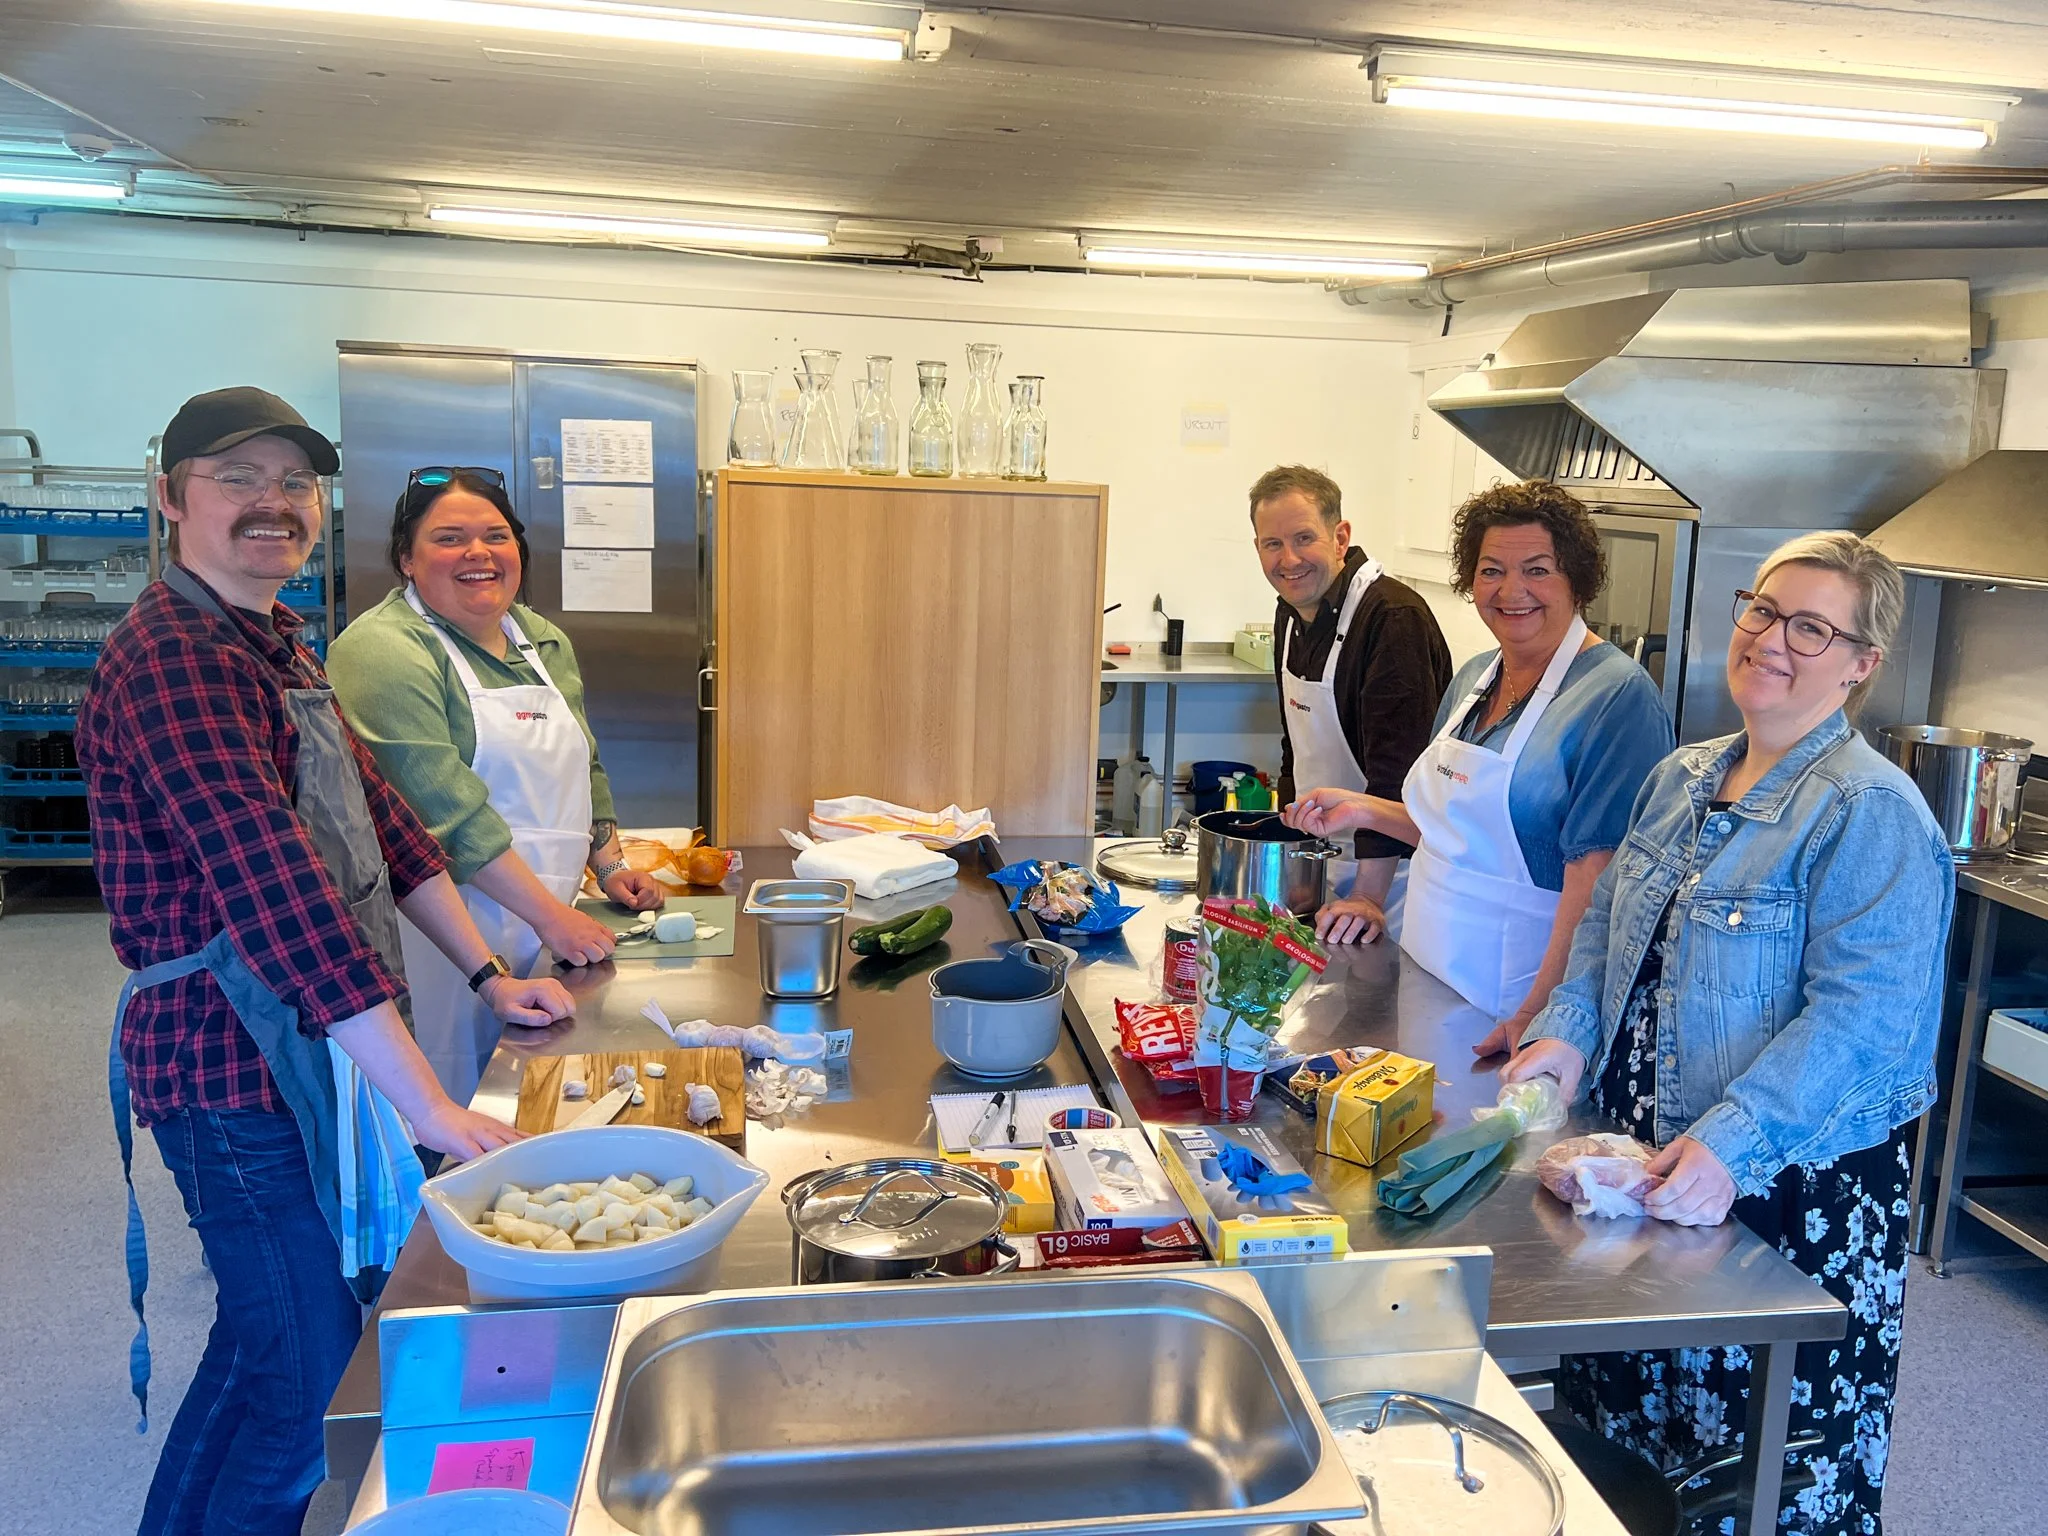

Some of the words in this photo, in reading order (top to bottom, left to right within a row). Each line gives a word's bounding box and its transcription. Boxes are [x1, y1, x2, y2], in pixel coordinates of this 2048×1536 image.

[1227, 918, 1259, 935] BASILIKUM
[1041, 1236, 1069, 1255] 6L
[1070, 1232, 1110, 1247] BASIC
